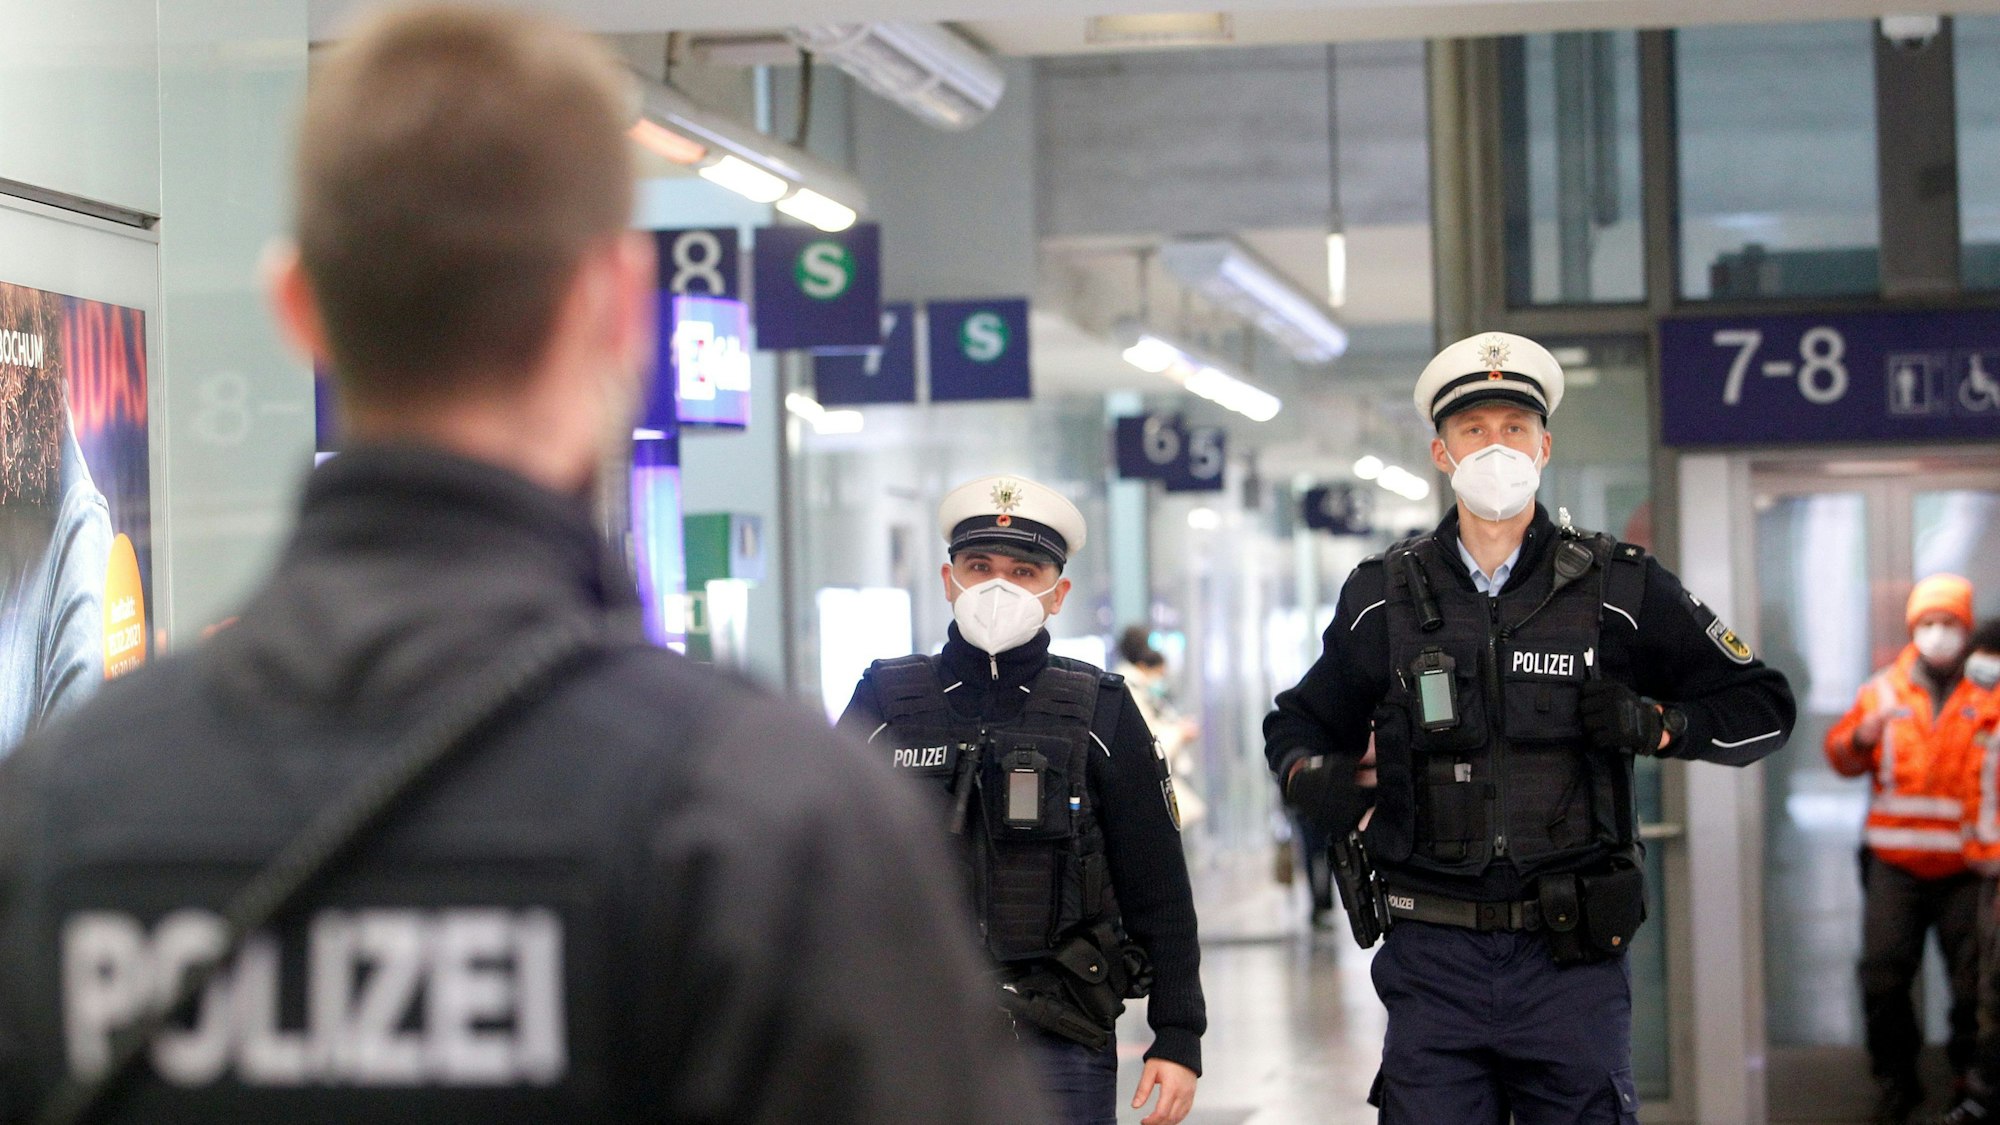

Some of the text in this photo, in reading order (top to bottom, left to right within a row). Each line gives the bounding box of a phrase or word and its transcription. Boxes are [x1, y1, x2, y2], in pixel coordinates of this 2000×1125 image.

[671, 231, 725, 294] 8
[801, 242, 849, 297] S
[963, 313, 1006, 362] S
[1712, 326, 1848, 405] 7-8
[1142, 414, 1181, 466] 6
[1512, 651, 1574, 676] POLIZEI
[893, 745, 947, 768] POLIZEI
[62, 905, 568, 1087] POLIZEI
